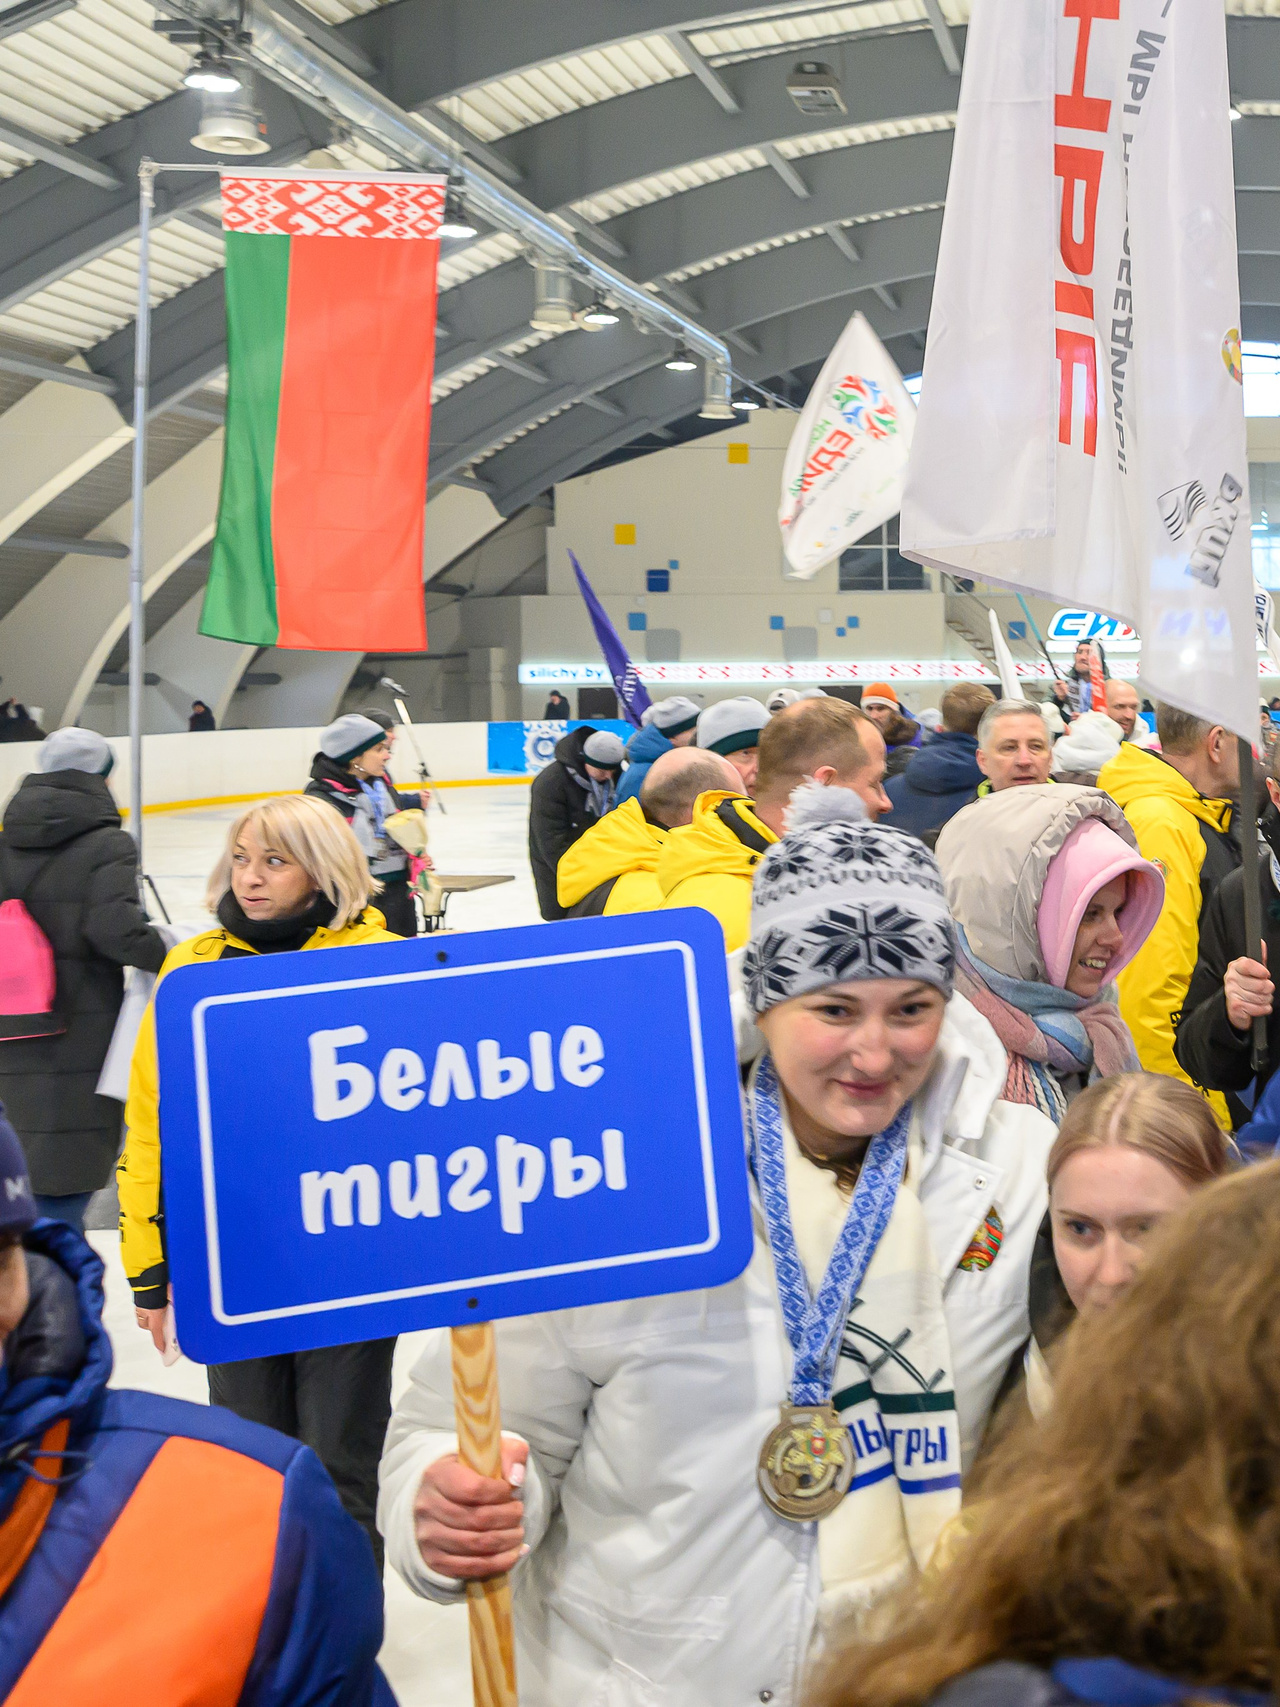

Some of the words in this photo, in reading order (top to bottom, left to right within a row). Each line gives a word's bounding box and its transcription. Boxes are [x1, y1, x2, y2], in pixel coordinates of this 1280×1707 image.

[528, 666, 604, 680] silichy.by
[308, 1025, 605, 1122] Белые
[300, 1129, 627, 1235] тигры
[888, 1425, 949, 1467] ГРЫ
